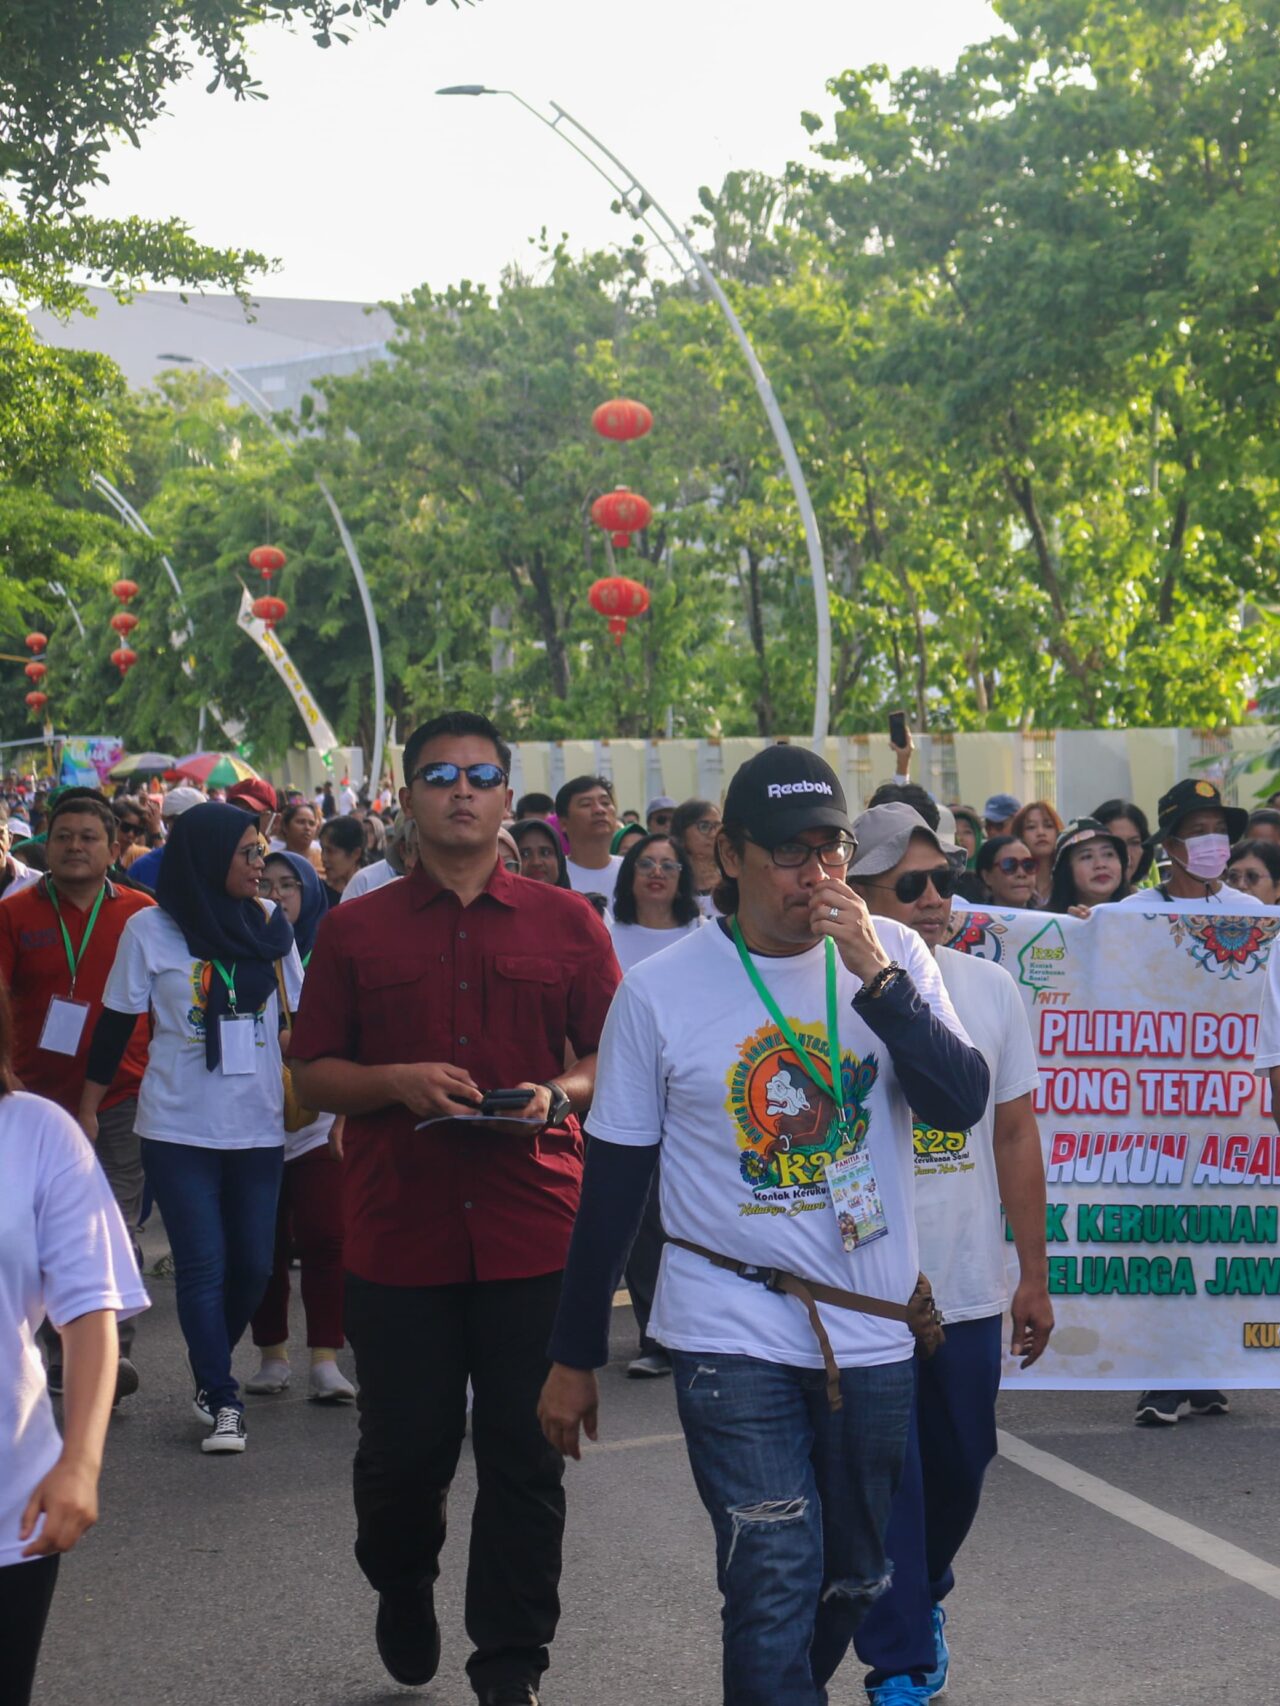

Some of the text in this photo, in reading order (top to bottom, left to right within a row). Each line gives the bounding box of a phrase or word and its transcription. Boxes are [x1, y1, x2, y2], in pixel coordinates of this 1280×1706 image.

[767, 780, 833, 798] Reebok
[1038, 991, 1071, 1005] NTT
[1039, 1010, 1187, 1058] PILIHAN
[1136, 1069, 1256, 1117] TETAP
[835, 1154, 860, 1169] PANITIA
[1046, 1131, 1189, 1185] RUKUN
[754, 1185, 830, 1201] Kontak Keruku
[1077, 1203, 1279, 1244] KERUKUNAN
[1046, 1256, 1197, 1295] ELUARGA
